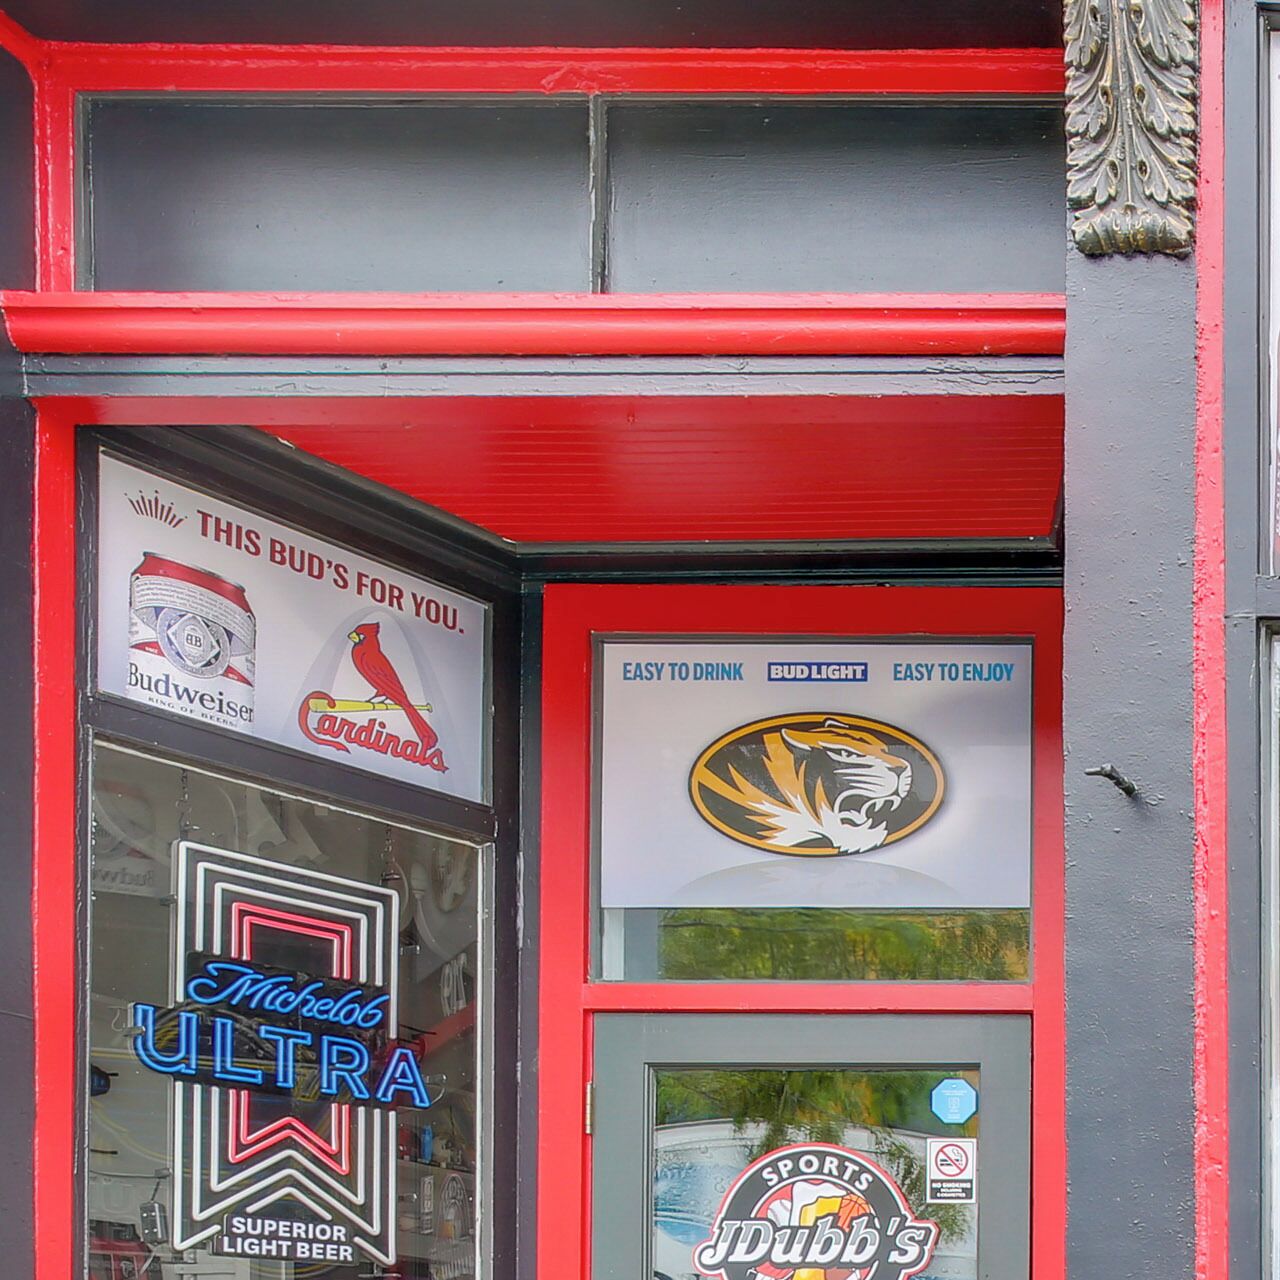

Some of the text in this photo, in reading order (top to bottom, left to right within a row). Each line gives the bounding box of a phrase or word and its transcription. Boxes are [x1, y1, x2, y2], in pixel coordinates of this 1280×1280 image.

[197, 509, 465, 634] THIS BUD'S FOR YOU.
[128, 662, 254, 722] Budweiser
[623, 662, 744, 681] EASY TO DRINK
[770, 664, 866, 680] BUD LIGHT
[893, 662, 1014, 682] EASY TO ENJOY
[298, 691, 449, 774] Cardinals
[187, 961, 391, 1029] Michelob
[132, 1001, 431, 1110] ULTRA
[761, 1154, 874, 1192] SPORTS
[223, 1236, 353, 1262] LIGHT BEER
[232, 1217, 347, 1243] SUPERIOR
[699, 1215, 925, 1266] JDubb's
